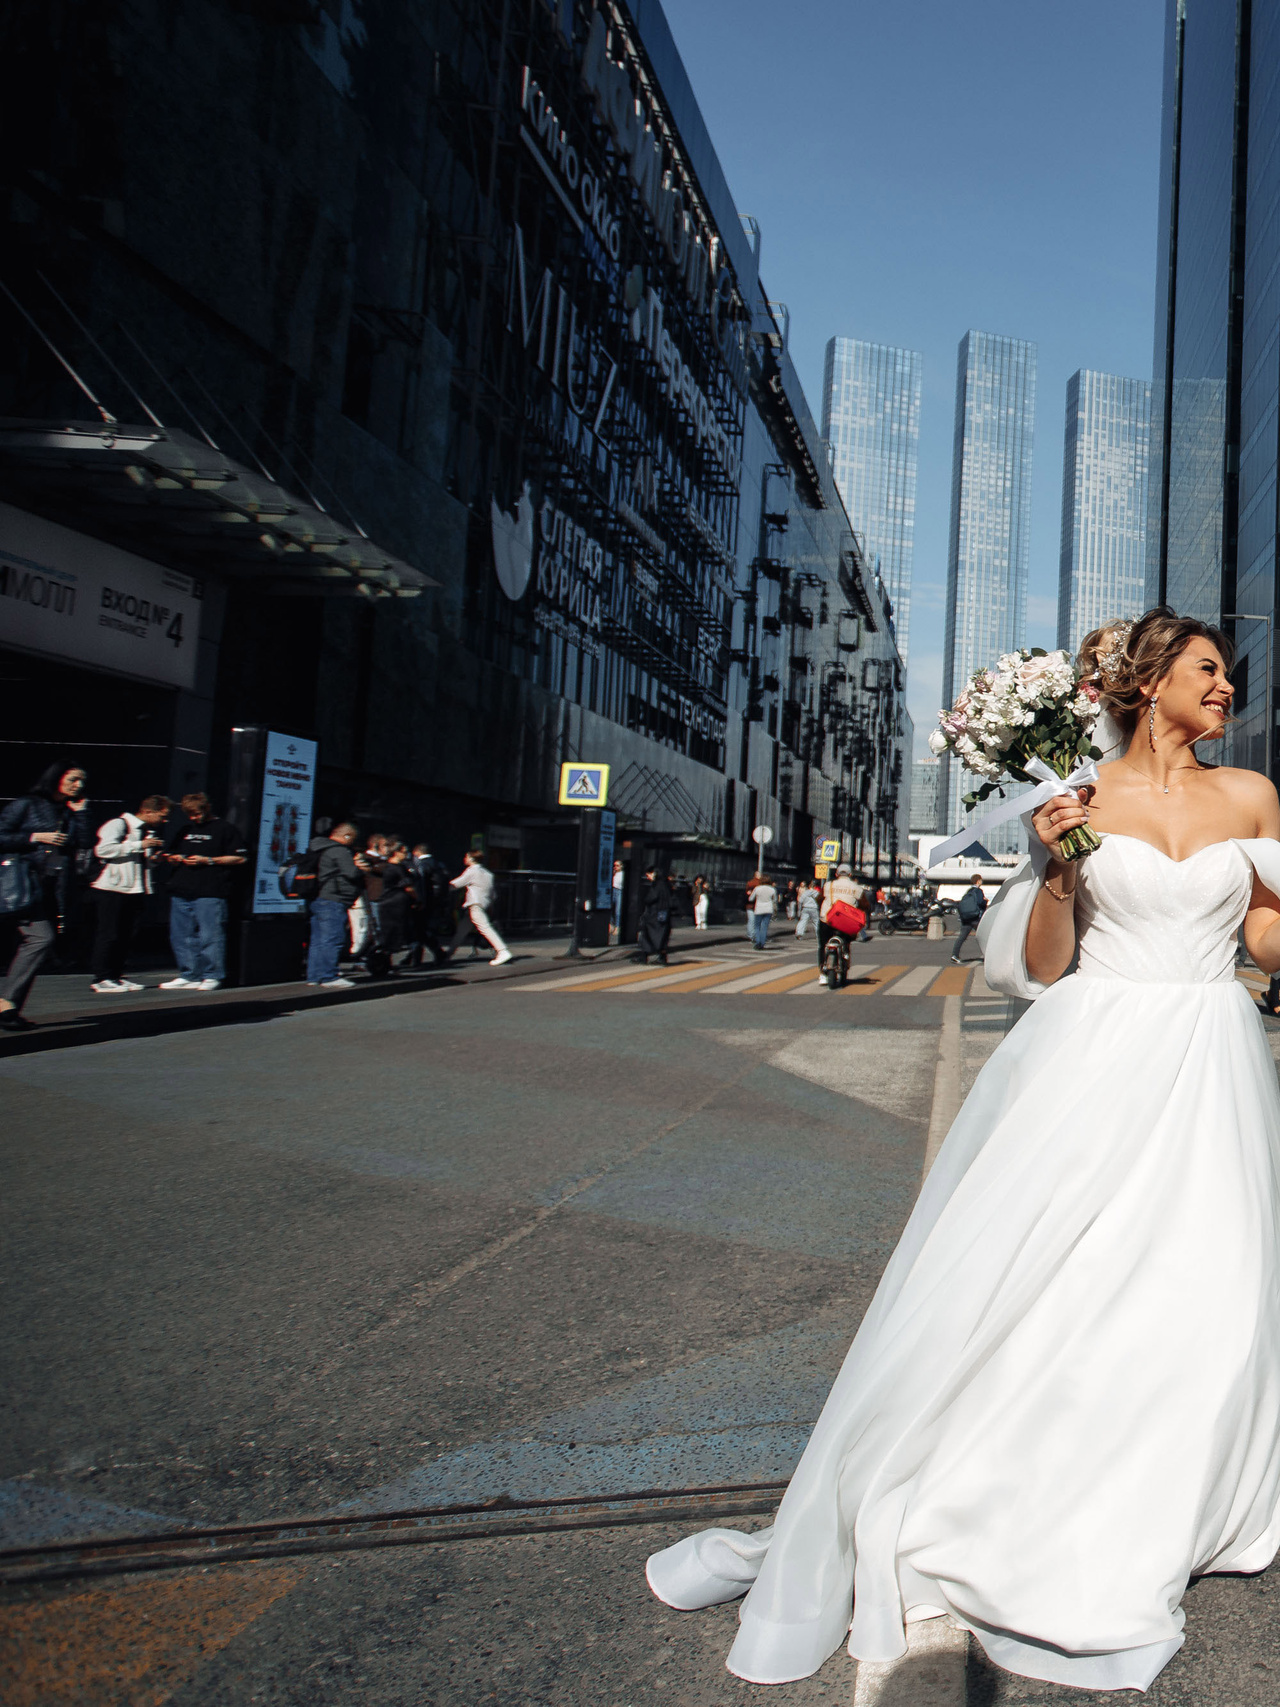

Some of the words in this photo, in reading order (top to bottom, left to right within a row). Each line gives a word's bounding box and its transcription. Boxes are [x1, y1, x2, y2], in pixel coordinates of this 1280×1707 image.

[521, 65, 579, 190] КИНО
[506, 220, 619, 452] MIUZ
[539, 497, 603, 584] СЛЕПАЯ
[101, 586, 151, 625] ВХОД
[536, 549, 603, 633] КУРИЦА
